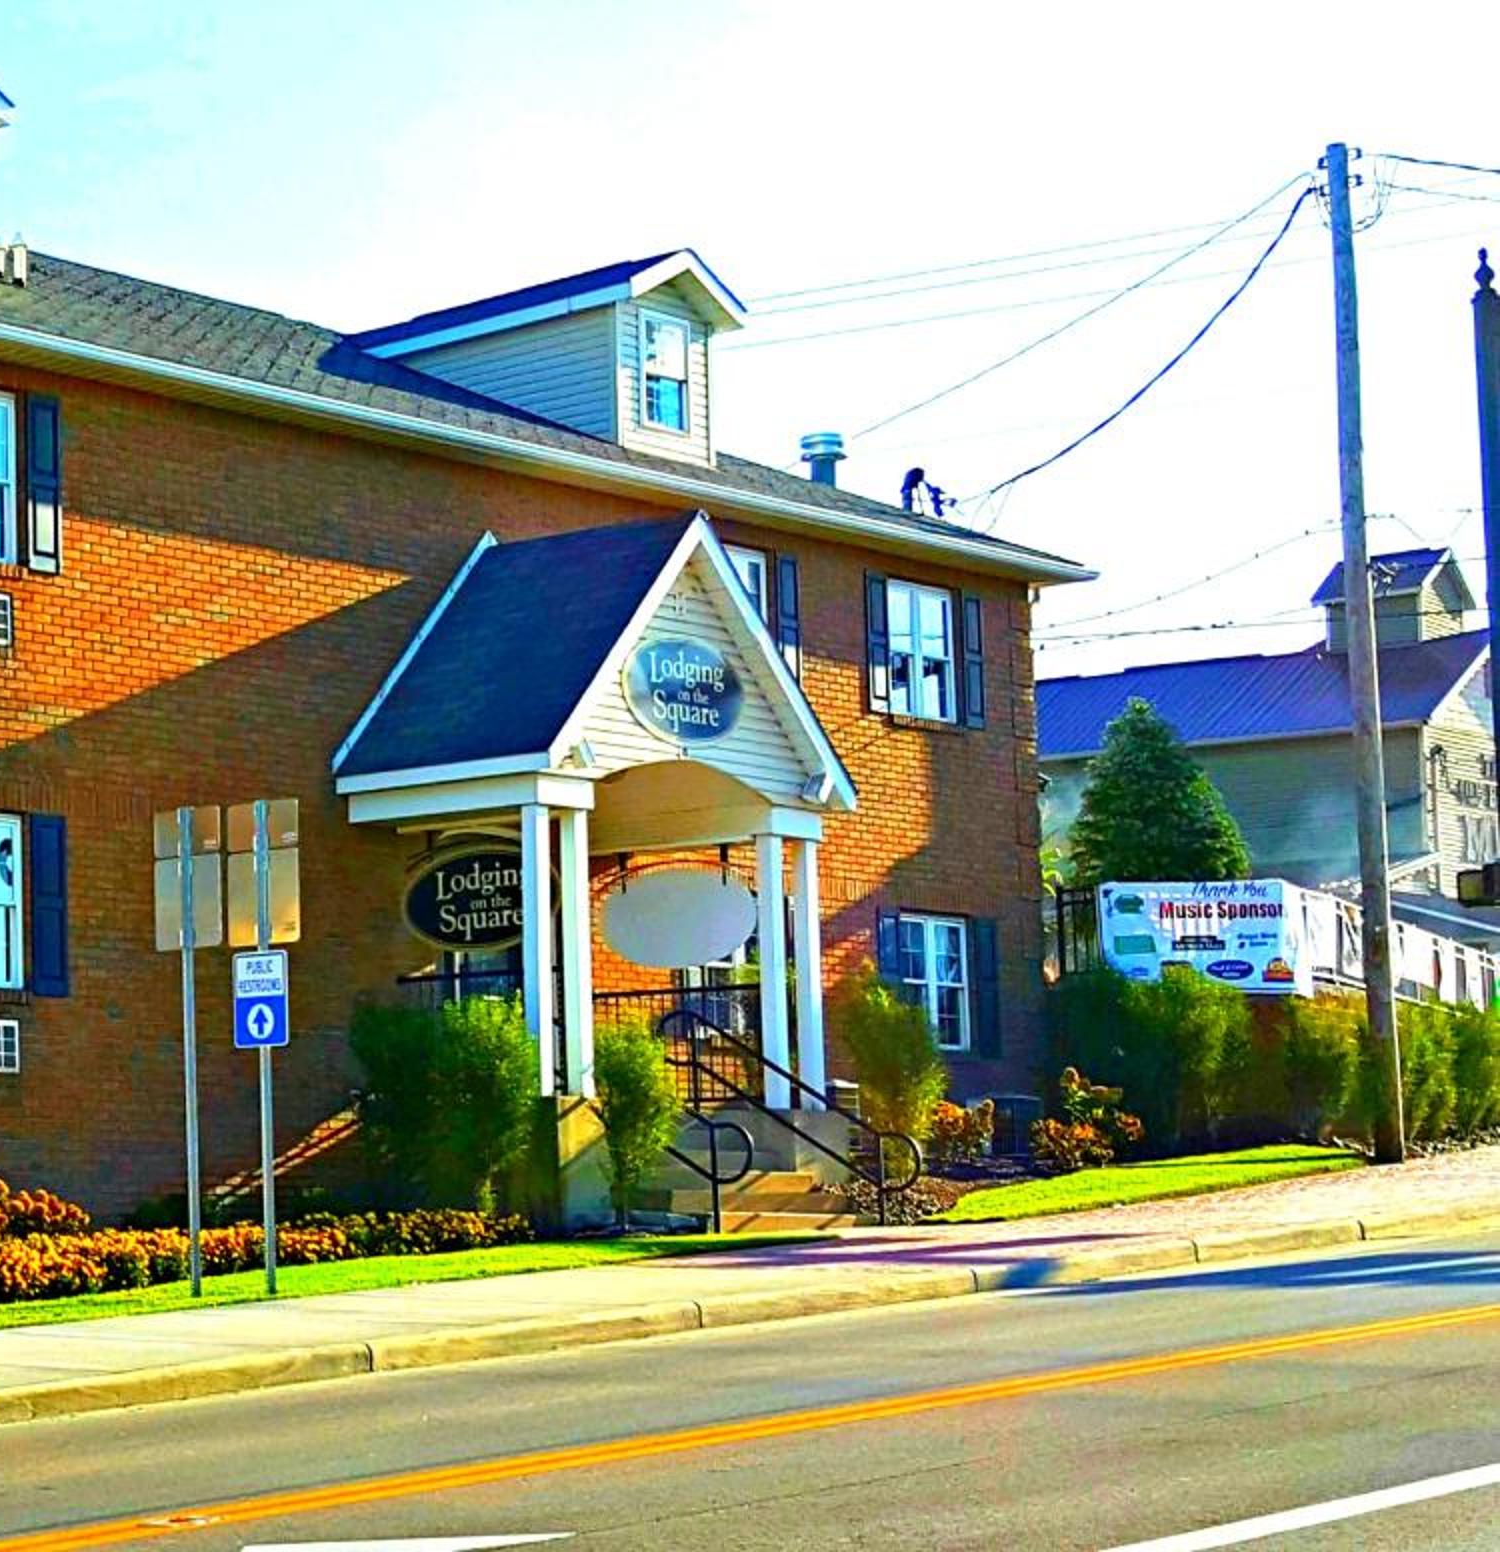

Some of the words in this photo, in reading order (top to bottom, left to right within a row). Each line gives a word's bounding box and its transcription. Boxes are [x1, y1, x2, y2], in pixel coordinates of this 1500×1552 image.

[648, 650, 725, 692] Lodging
[677, 690, 690, 702] on
[692, 688, 709, 705] the
[653, 689, 719, 733] Square
[436, 861, 523, 900] Lodgin
[1191, 882, 1239, 898] Thank
[1243, 882, 1269, 898] You
[470, 900, 487, 911] on
[491, 894, 512, 908] the
[1159, 900, 1213, 920] Music
